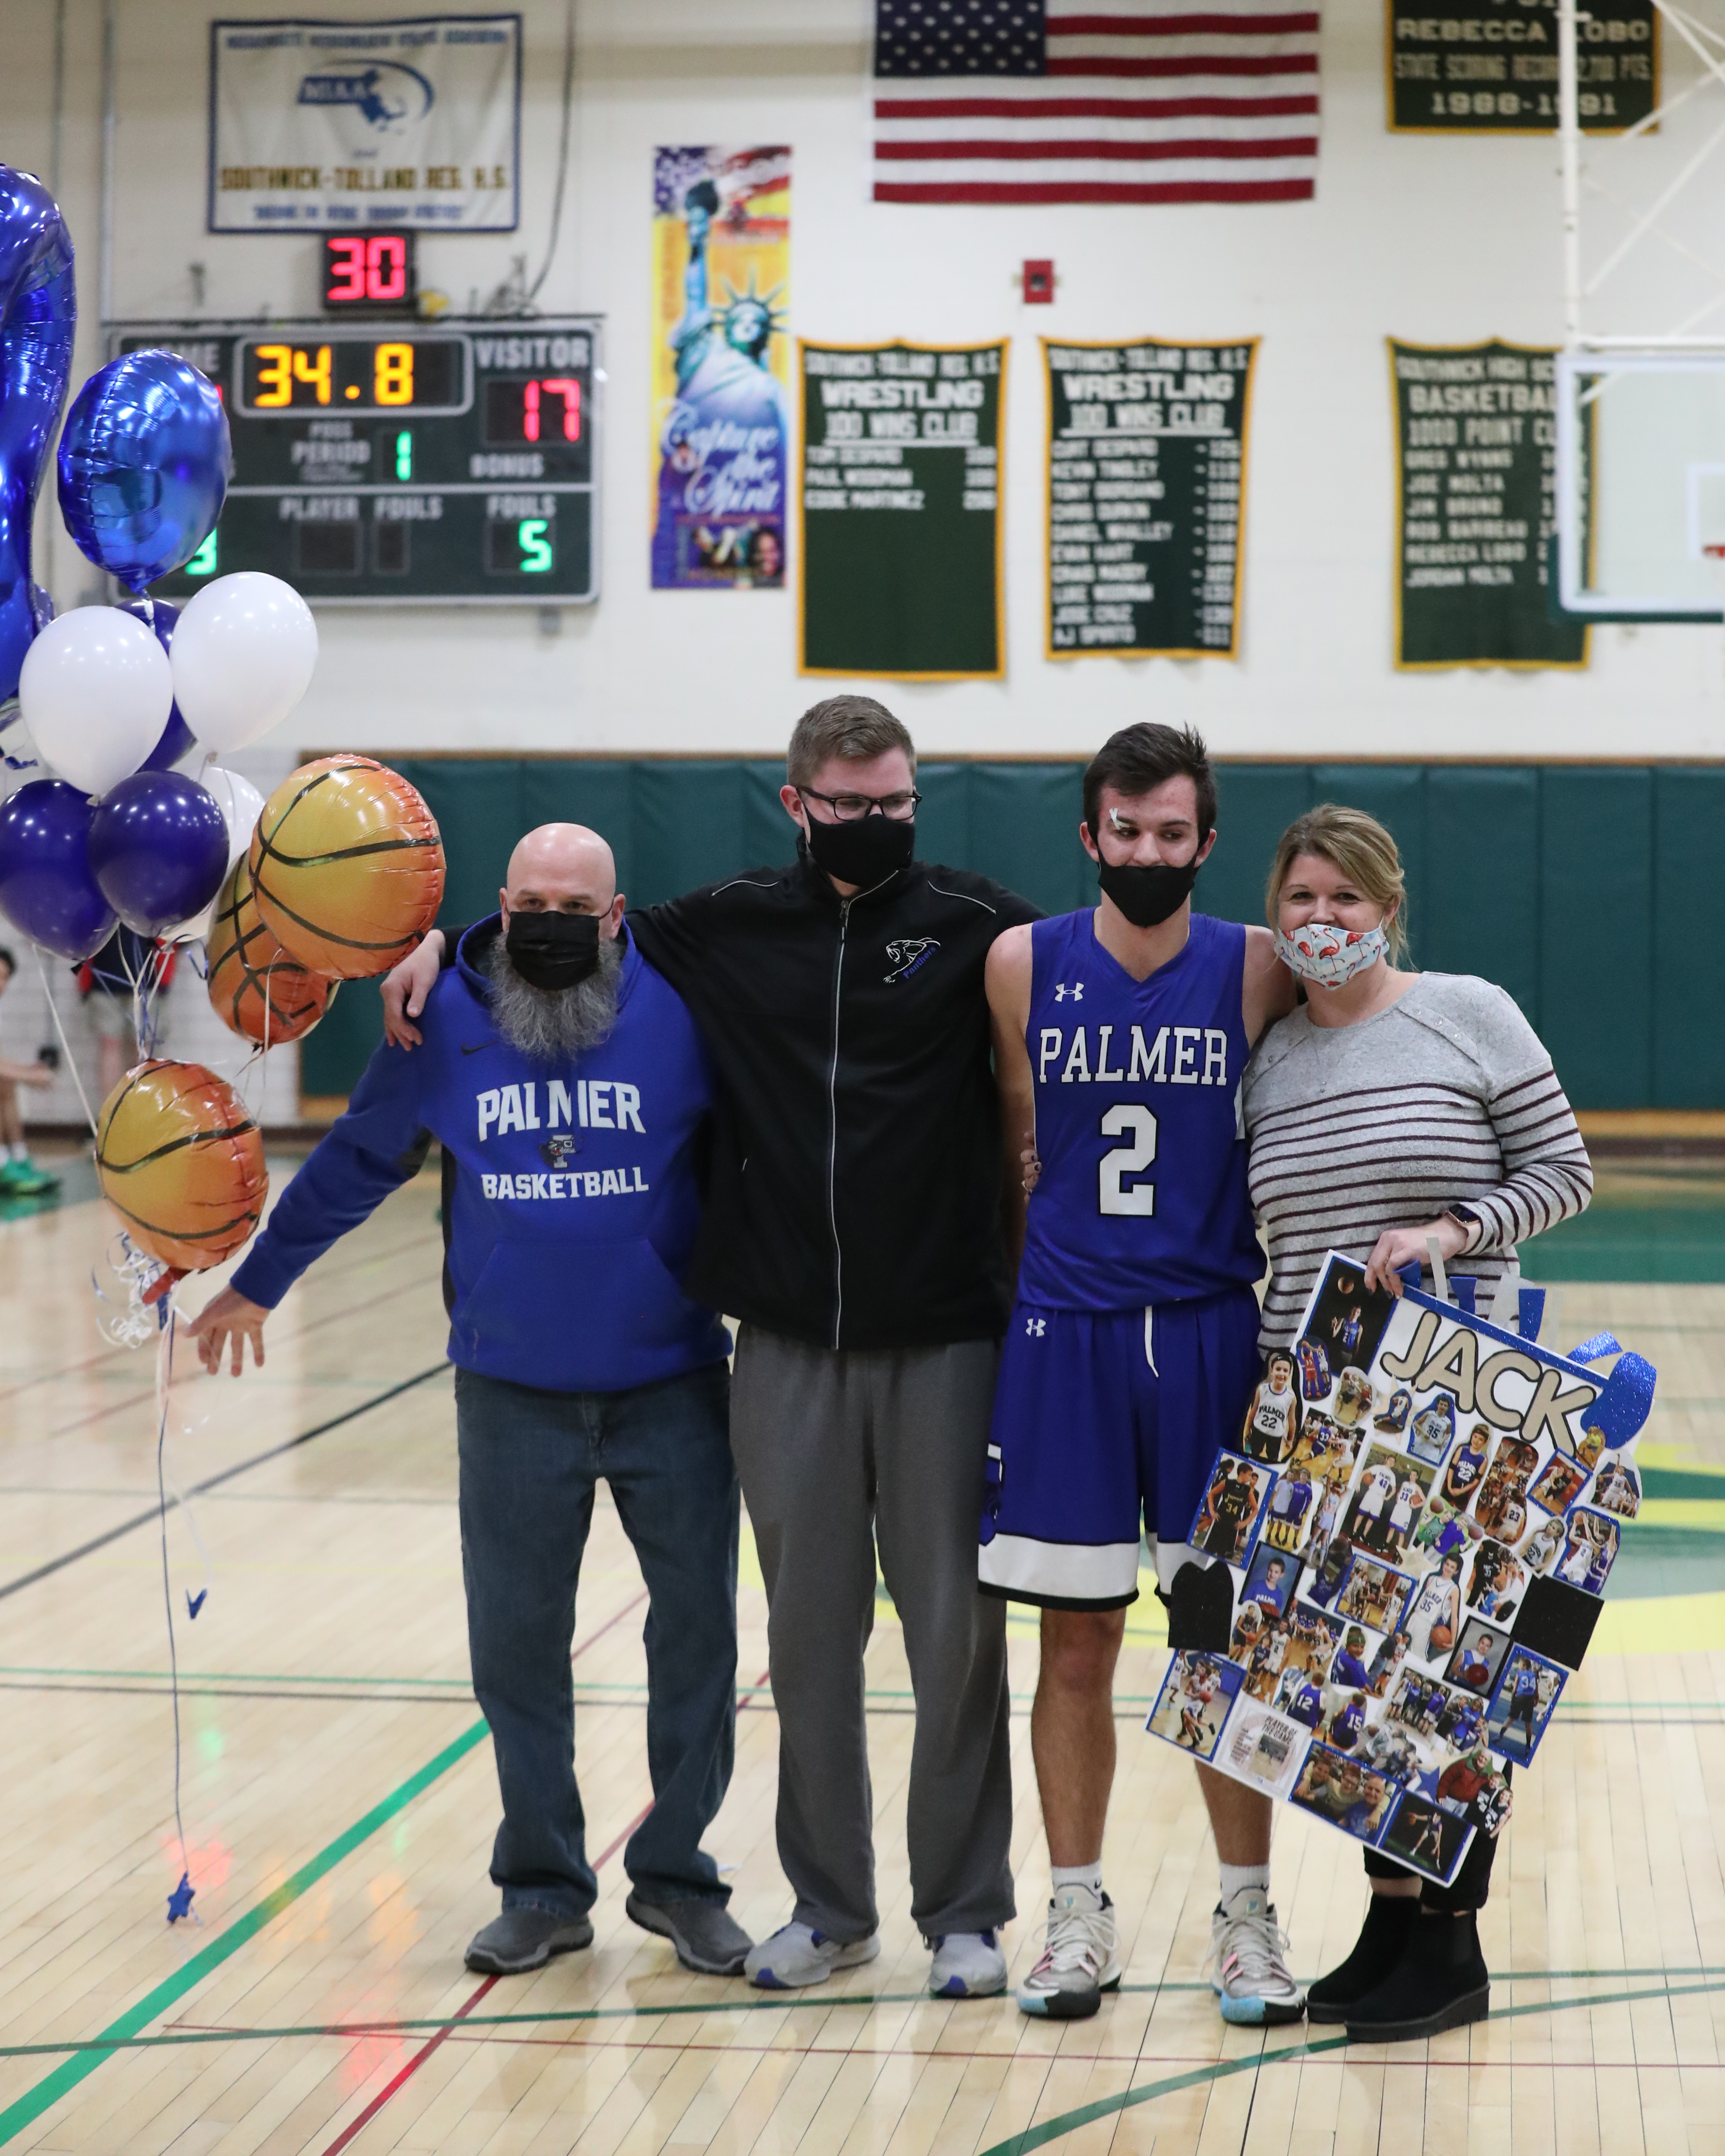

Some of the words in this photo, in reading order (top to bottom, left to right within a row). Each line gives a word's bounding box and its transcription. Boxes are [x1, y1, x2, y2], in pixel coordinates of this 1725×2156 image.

[1396, 20, 1547, 42] REBECCA
[1577, 20, 1649, 43] OBO
[1431, 92, 1616, 116] 1988-191
[326, 237, 406, 301] 30
[475, 337, 588, 368] VISITOR
[253, 343, 414, 408] 34.8
[1063, 373, 1235, 400] WRESTLING
[821, 380, 984, 408] WRESTLING
[524, 379, 581, 441] 17
[1070, 403, 1107, 429] 100
[1115, 403, 1162, 428] WINS
[1169, 403, 1225, 428] CLUB
[657, 398, 779, 461] Capture
[826, 411, 863, 437] 100
[869, 412, 917, 437] WINS
[923, 412, 978, 437] CLUB
[1409, 418, 1457, 445] 1000
[1465, 417, 1523, 445] POINT
[291, 441, 371, 463] PERIOD
[396, 430, 412, 481] 1
[470, 453, 544, 478] BONUS
[685, 465, 781, 519] Spirit
[279, 497, 359, 520] PLAYER
[374, 497, 443, 519] FOULS
[487, 496, 556, 517] FOULS
[518, 520, 552, 573] 5
[903, 947, 936, 979] Panthers
[1039, 1025, 1228, 1087] PALMER
[476, 1079, 646, 1142] PALMER
[1098, 1102, 1159, 1217] 2
[481, 1166, 649, 1200] BASKETBALL
[1379, 1309, 1597, 1458] JACK
[1258, 1405, 1285, 1423] PALMER
[1261, 1415, 1277, 1429] 22
[1320, 1432, 1329, 1442] 33
[1427, 1425, 1440, 1439] 35
[1379, 1479, 1388, 1488] 42
[1458, 1467, 1472, 1482] 22
[1226, 1503, 1238, 1514] 34
[1509, 1509, 1520, 1522] 23
[1420, 1600, 1434, 1612] 35
[1520, 1676, 1536, 1690] 34
[1297, 1693, 1314, 1711] 12
[1265, 1716, 1289, 1733] PLAYER
[1347, 1713, 1364, 1732] 15
